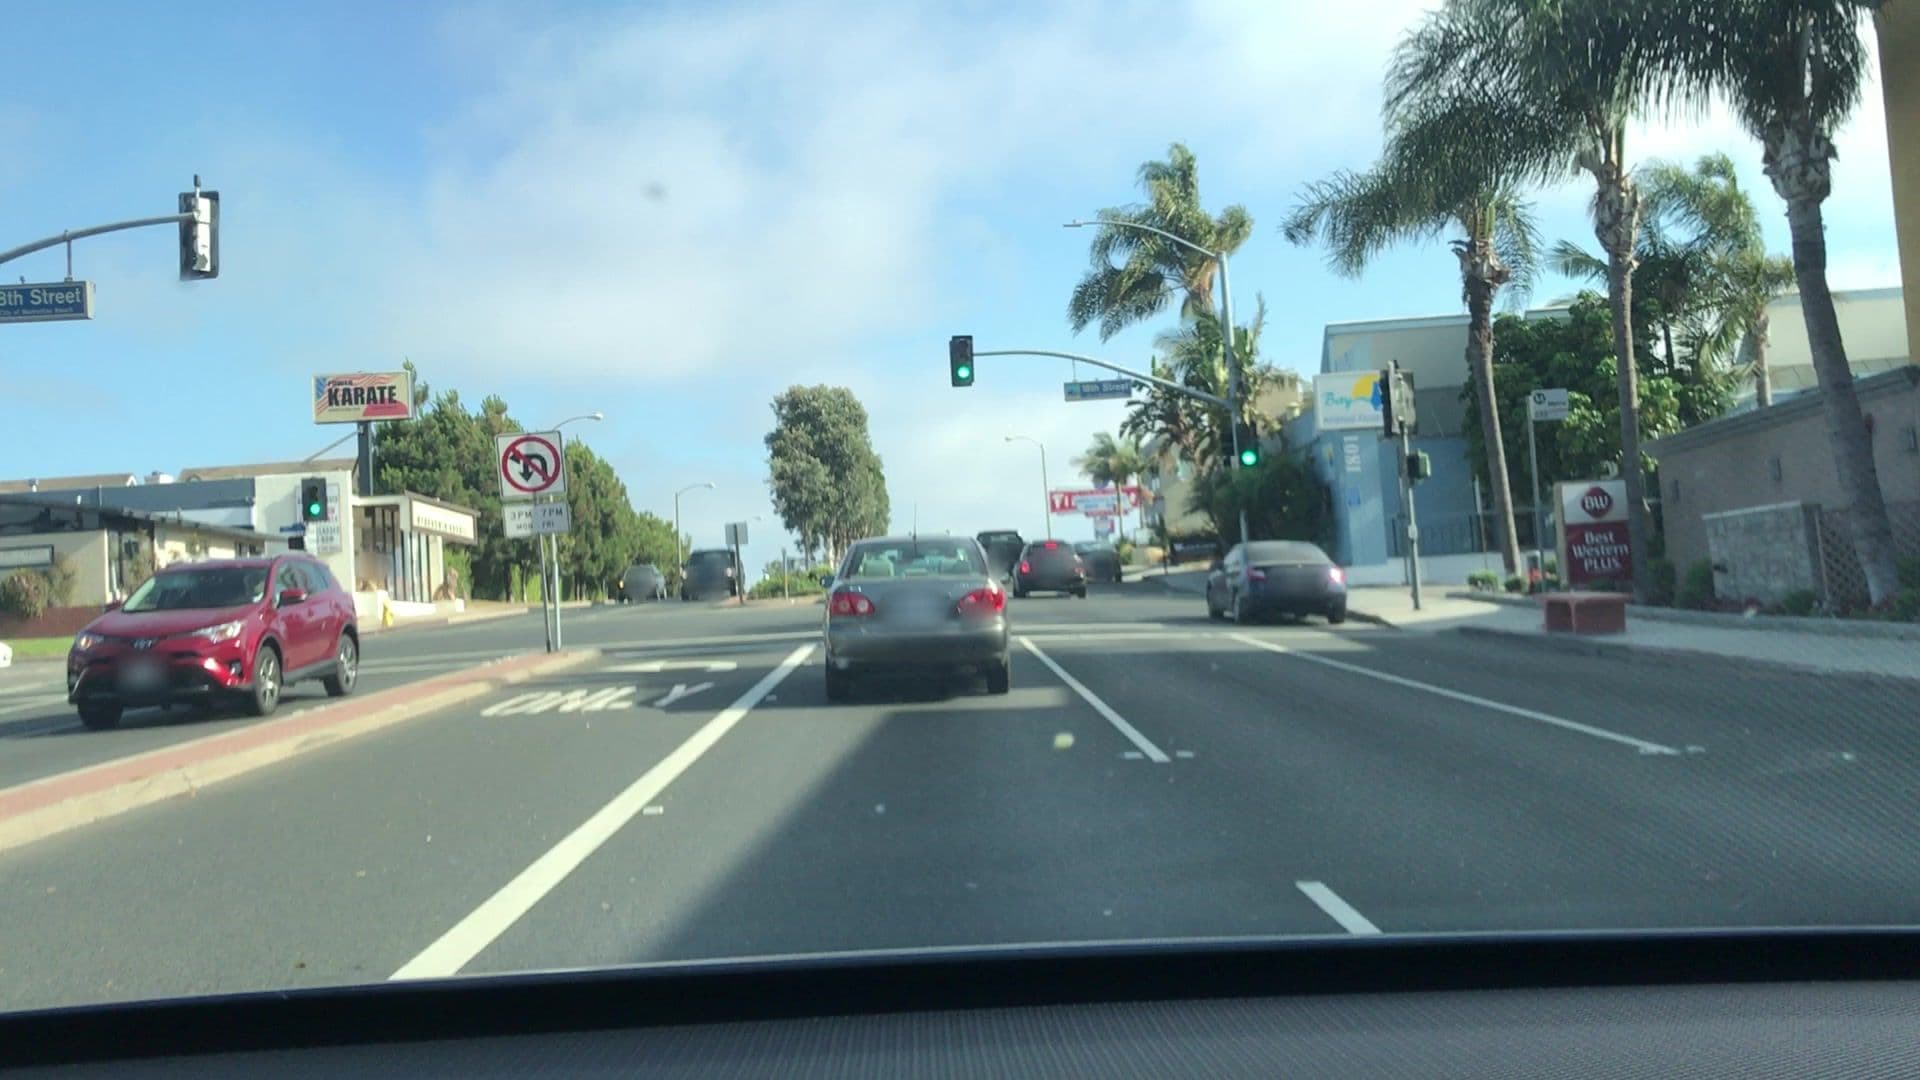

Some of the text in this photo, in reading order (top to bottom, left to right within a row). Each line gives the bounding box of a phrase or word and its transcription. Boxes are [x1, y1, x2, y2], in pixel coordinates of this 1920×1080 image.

[30, 288, 81, 305] Street
[1102, 382, 1129, 392] Street
[327, 385, 398, 406] KARATE
[1325, 391, 1353, 410] Bay
[1584, 495, 1609, 510] BW
[1584, 532, 1615, 545] Best
[1572, 543, 1629, 559] Western
[1584, 557, 1622, 573] PLUS
[480, 682, 716, 716] ONLY
